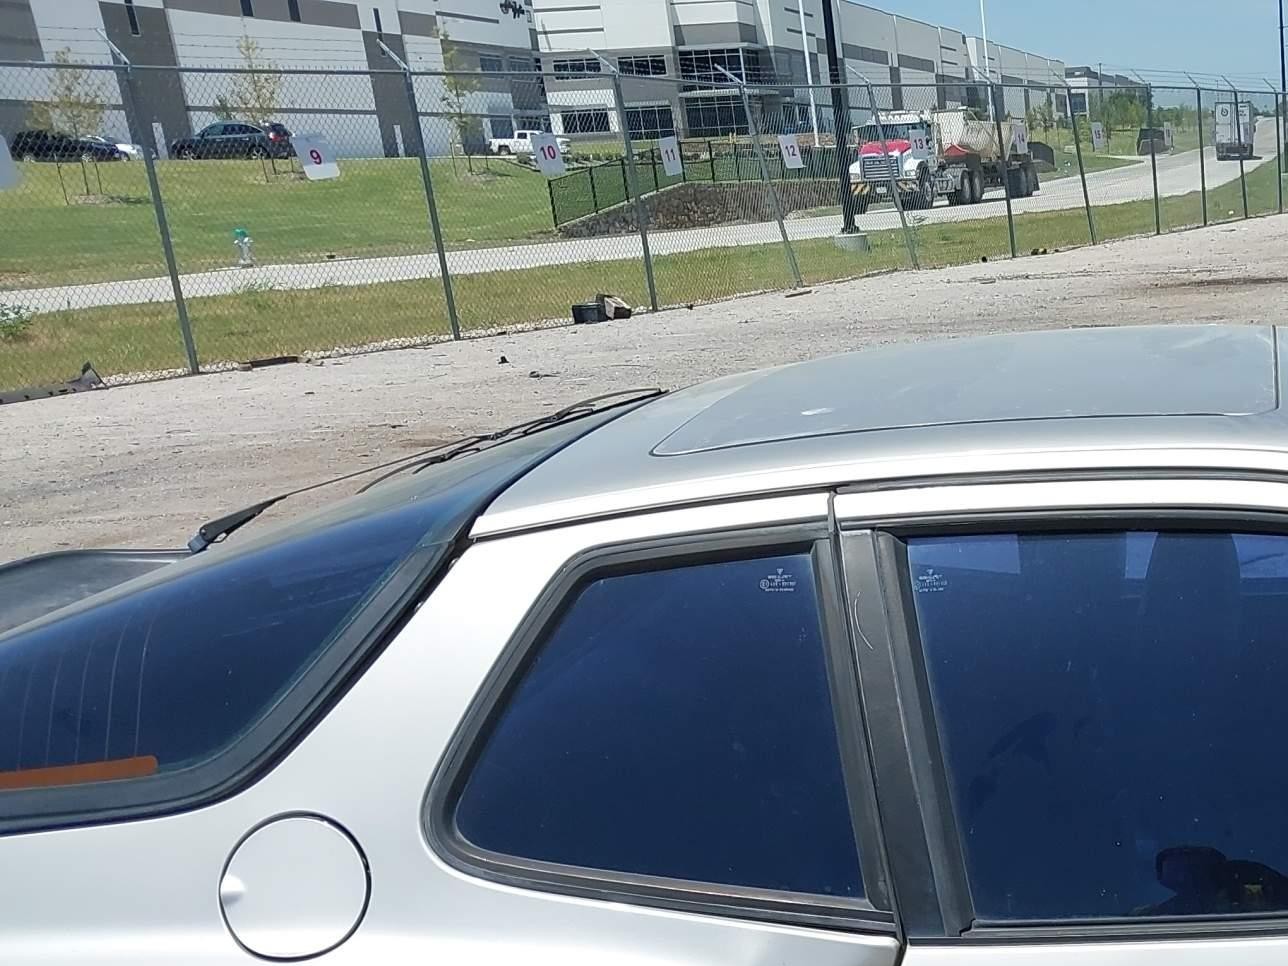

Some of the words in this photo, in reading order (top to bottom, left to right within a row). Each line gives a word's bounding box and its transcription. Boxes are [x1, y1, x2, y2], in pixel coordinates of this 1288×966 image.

[914, 138, 924, 150] 13
[310, 149, 322, 165] 9
[540, 145, 556, 160] 10
[665, 149, 676, 161] 11
[785, 145, 797, 157] 12
